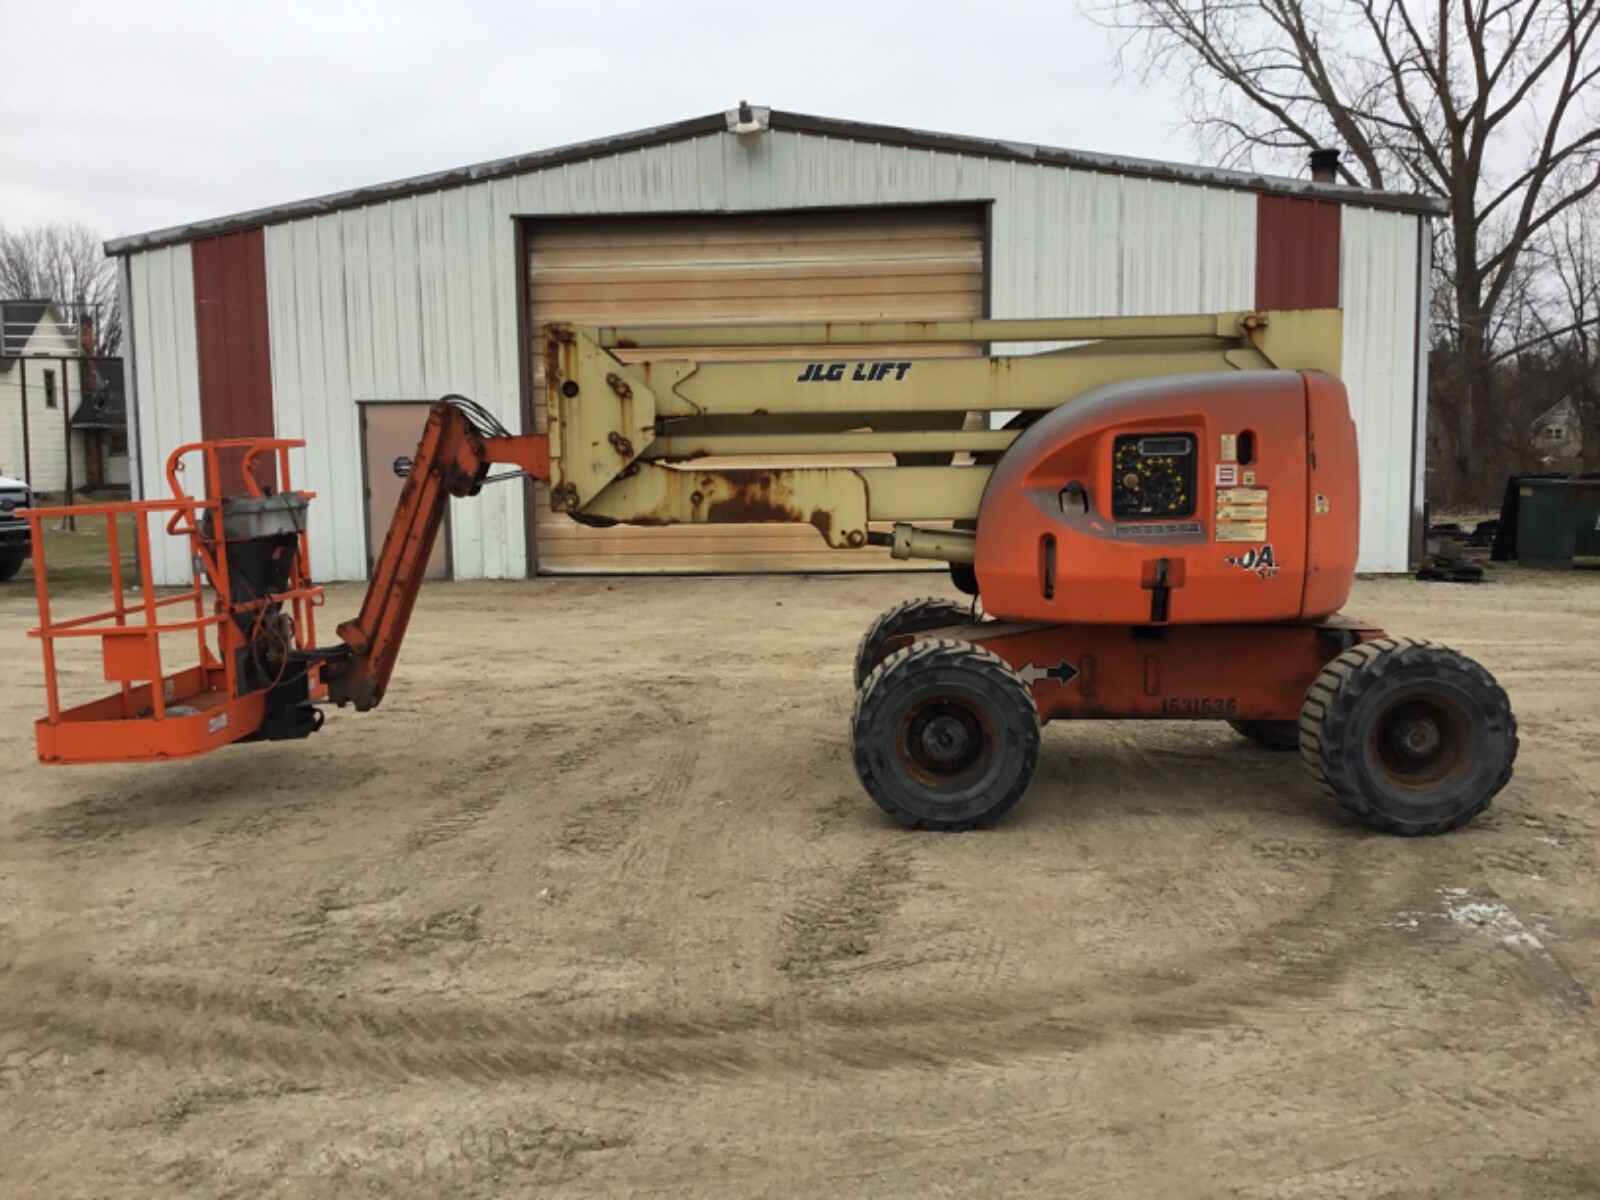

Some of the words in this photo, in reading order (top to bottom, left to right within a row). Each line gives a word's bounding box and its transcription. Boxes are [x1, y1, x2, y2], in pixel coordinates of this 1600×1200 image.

[797, 363, 847, 382] JLG
[852, 362, 913, 382] LIFT
[1162, 697, 1237, 715] 1531536
